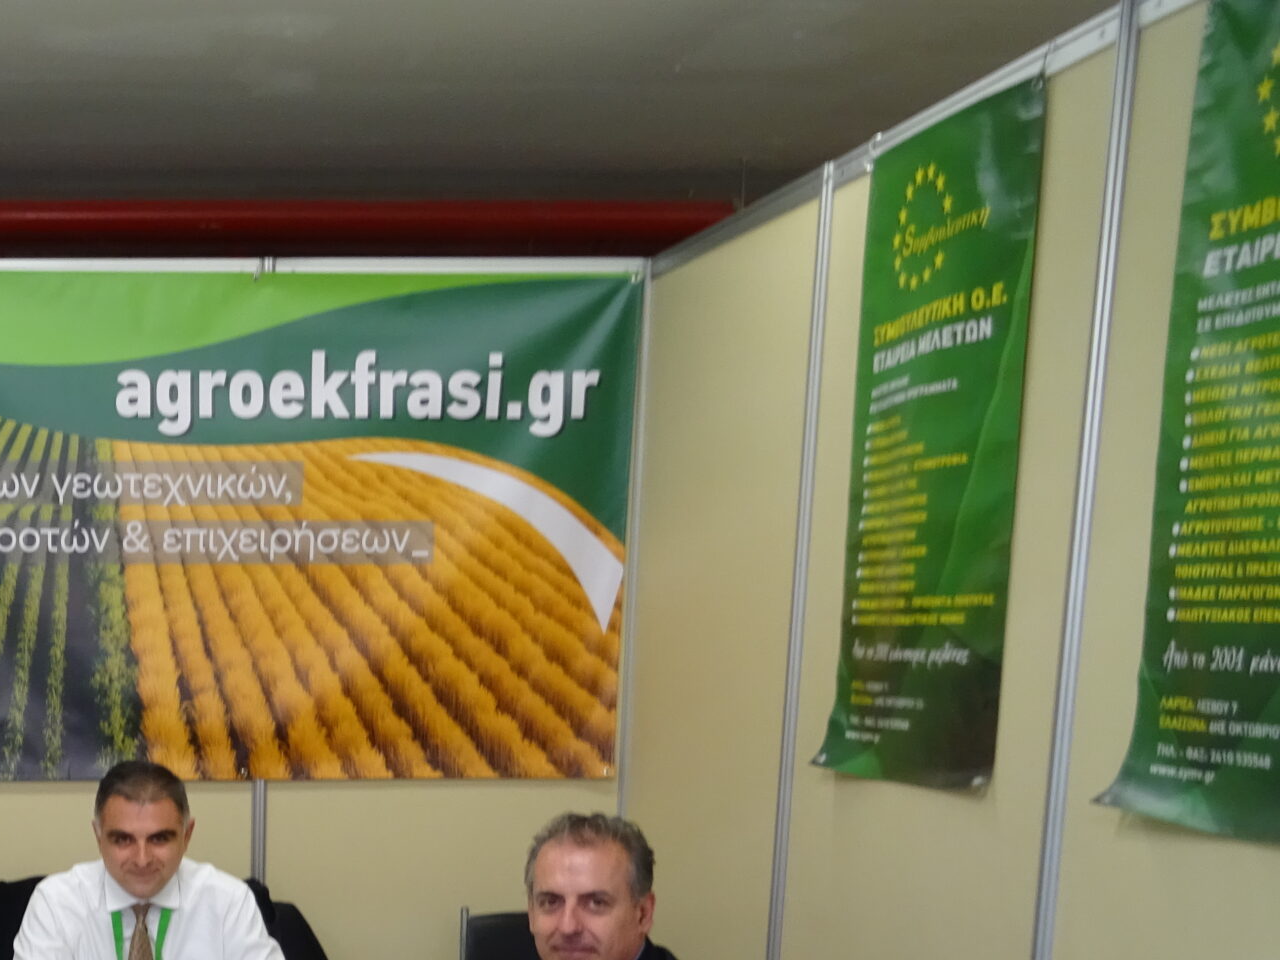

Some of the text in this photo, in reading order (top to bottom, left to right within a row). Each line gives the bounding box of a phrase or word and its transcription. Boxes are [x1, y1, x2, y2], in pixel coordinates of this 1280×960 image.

[1209, 196, 1280, 240] ΣΥΜΒ
[115, 349, 601, 438] agroekfrasi.gr
[51, 465, 294, 507] γεωτεχνικών,
[122, 523, 149, 554] &
[1210, 645, 1244, 672] 2001
[1228, 721, 1280, 740] ΟΚΤΩΒΡΙΟ
